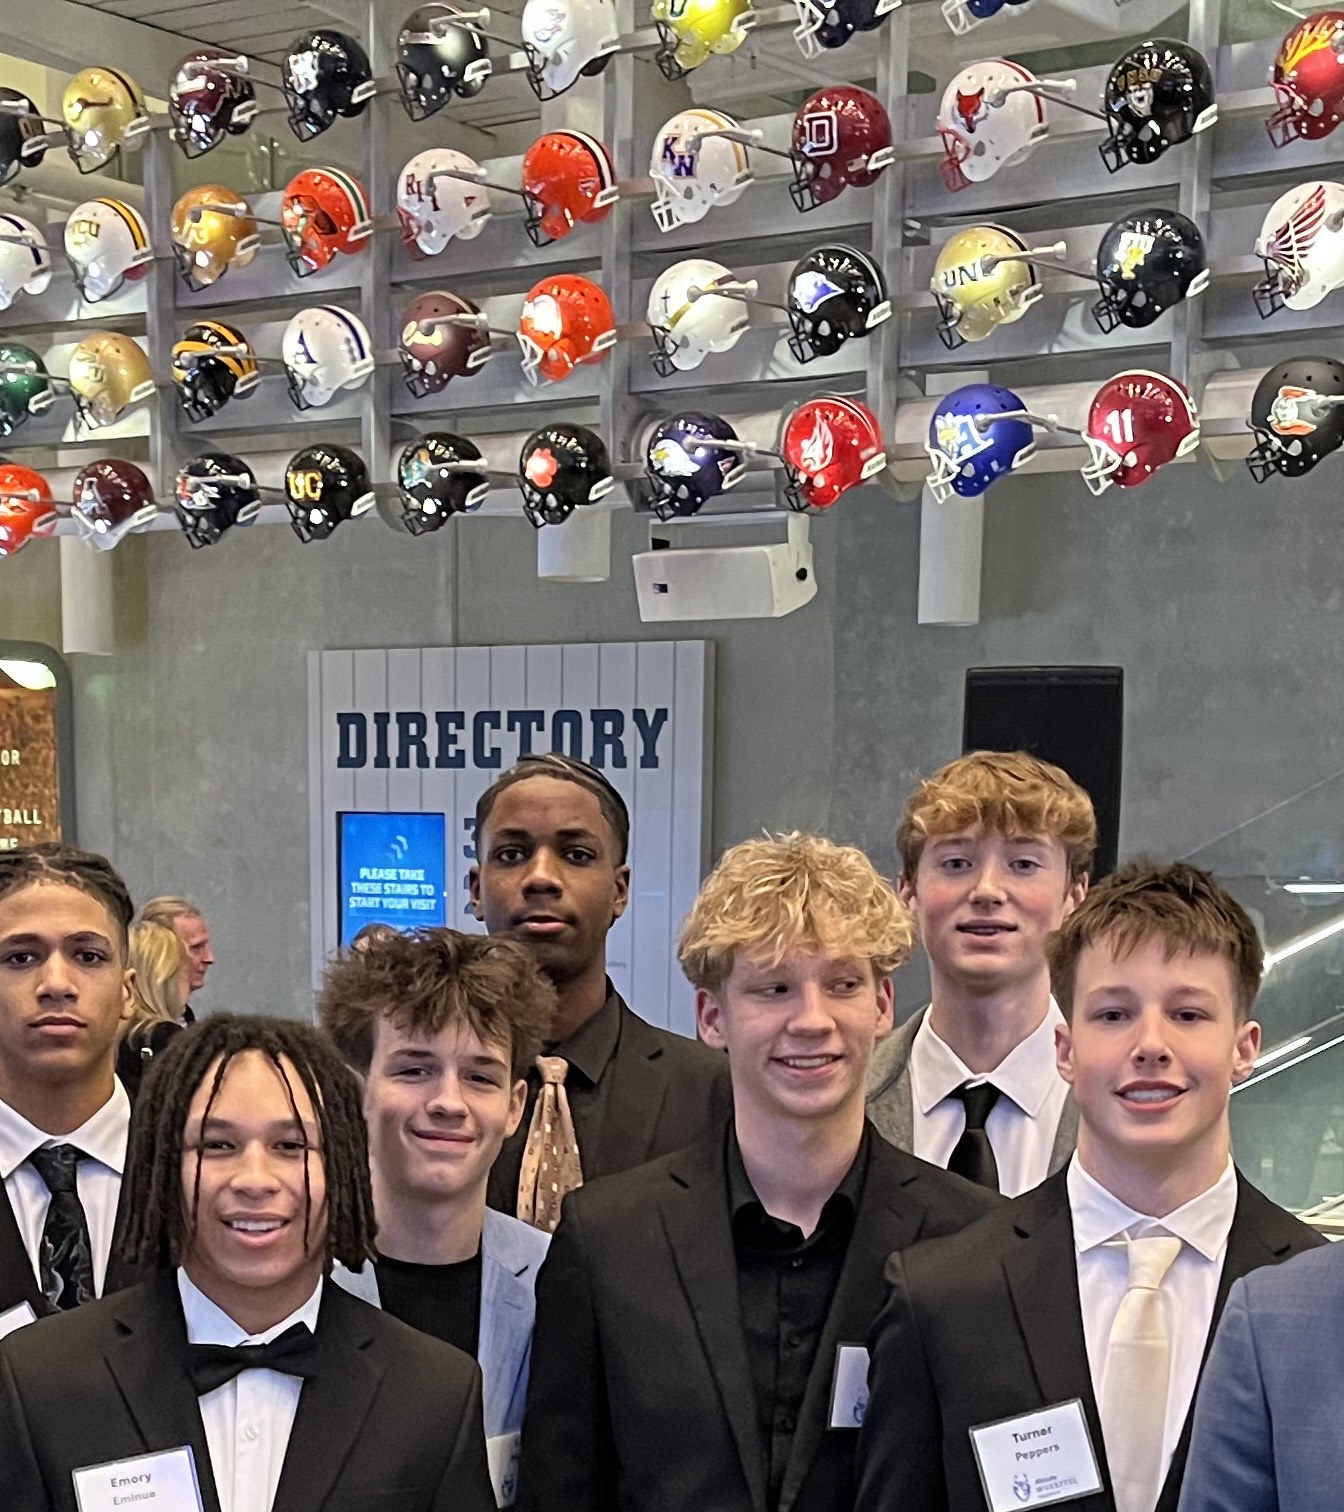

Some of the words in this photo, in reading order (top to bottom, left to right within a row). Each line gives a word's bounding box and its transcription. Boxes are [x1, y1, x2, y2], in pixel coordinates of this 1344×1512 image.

[336, 708, 668, 769] DIRECTORY
[359, 867, 397, 881] PLEASE
[351, 881, 382, 895] THESE
[419, 884, 435, 896] TO
[349, 896, 381, 909] START
[410, 898, 436, 911] VISIT
[1012, 1425, 1053, 1444] Turner
[1014, 1443, 1061, 1462] Peppers
[110, 1472, 152, 1489] Emory
[112, 1490, 157, 1506] Eminue
